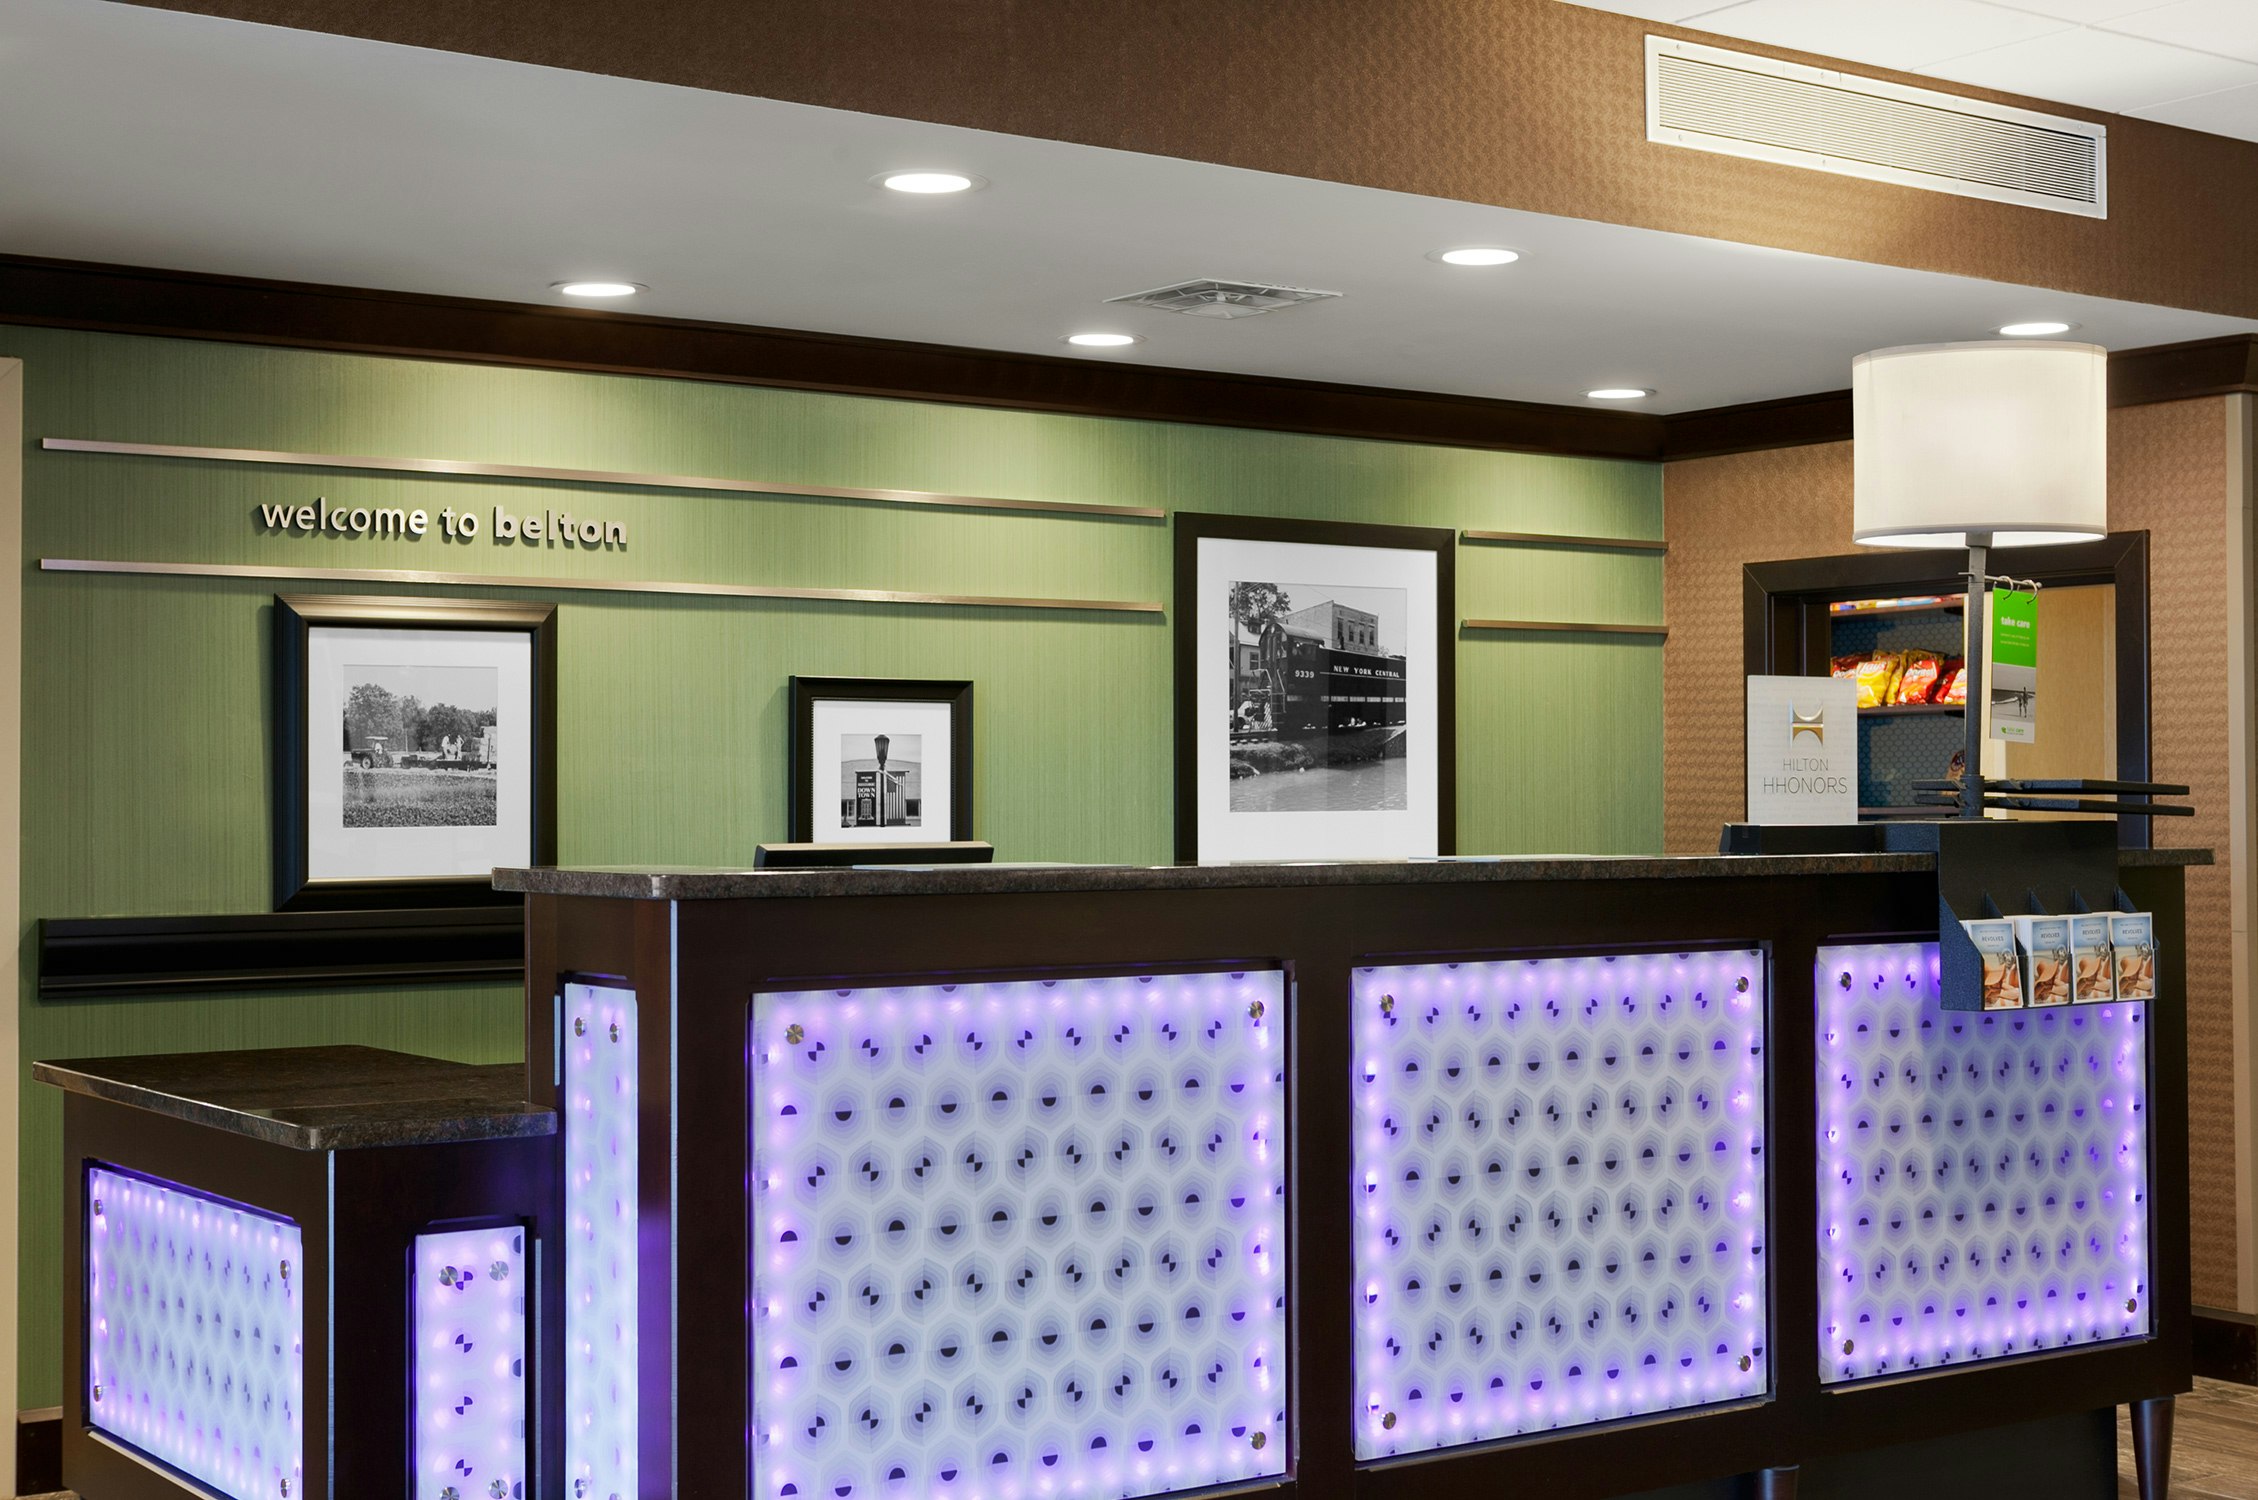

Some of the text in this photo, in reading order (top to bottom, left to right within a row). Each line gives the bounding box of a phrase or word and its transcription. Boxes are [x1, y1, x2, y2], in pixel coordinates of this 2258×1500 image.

[260, 496, 628, 545] welcome to belton
[2000, 616, 2031, 629] take care
[1294, 670, 1315, 678] 9339
[1333, 665, 1400, 678] NEW YORK CENTRAL
[1783, 758, 1829, 772] HILTON
[1763, 776, 1848, 794] HHONORS
